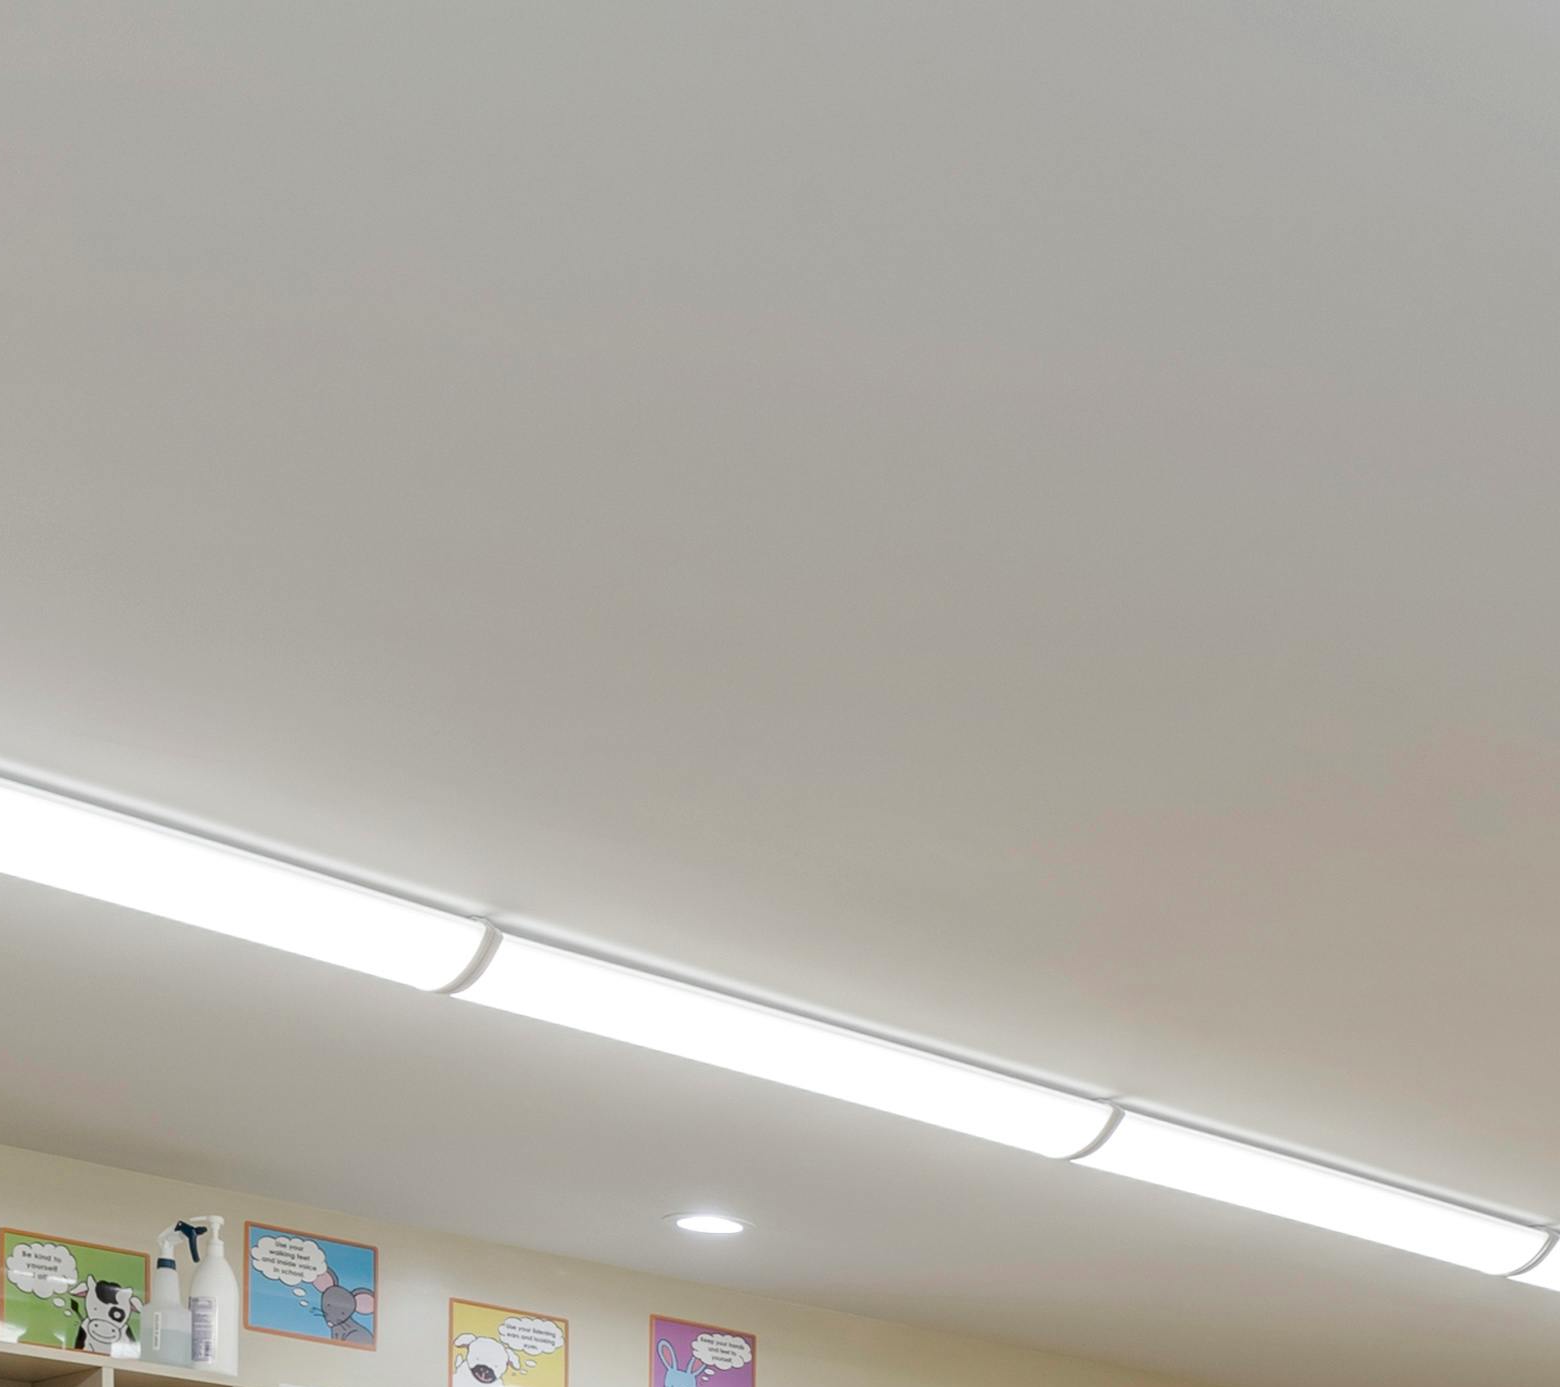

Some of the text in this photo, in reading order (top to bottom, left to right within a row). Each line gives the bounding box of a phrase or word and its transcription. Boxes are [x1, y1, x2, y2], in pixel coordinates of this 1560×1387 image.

[289, 1242, 304, 1251] your
[34, 1252, 52, 1261] kind
[269, 1249, 311, 1261] walking feet
[262, 1256, 317, 1271] and inside voice
[532, 1327, 556, 1339] listening
[534, 1336, 556, 1347] looking
